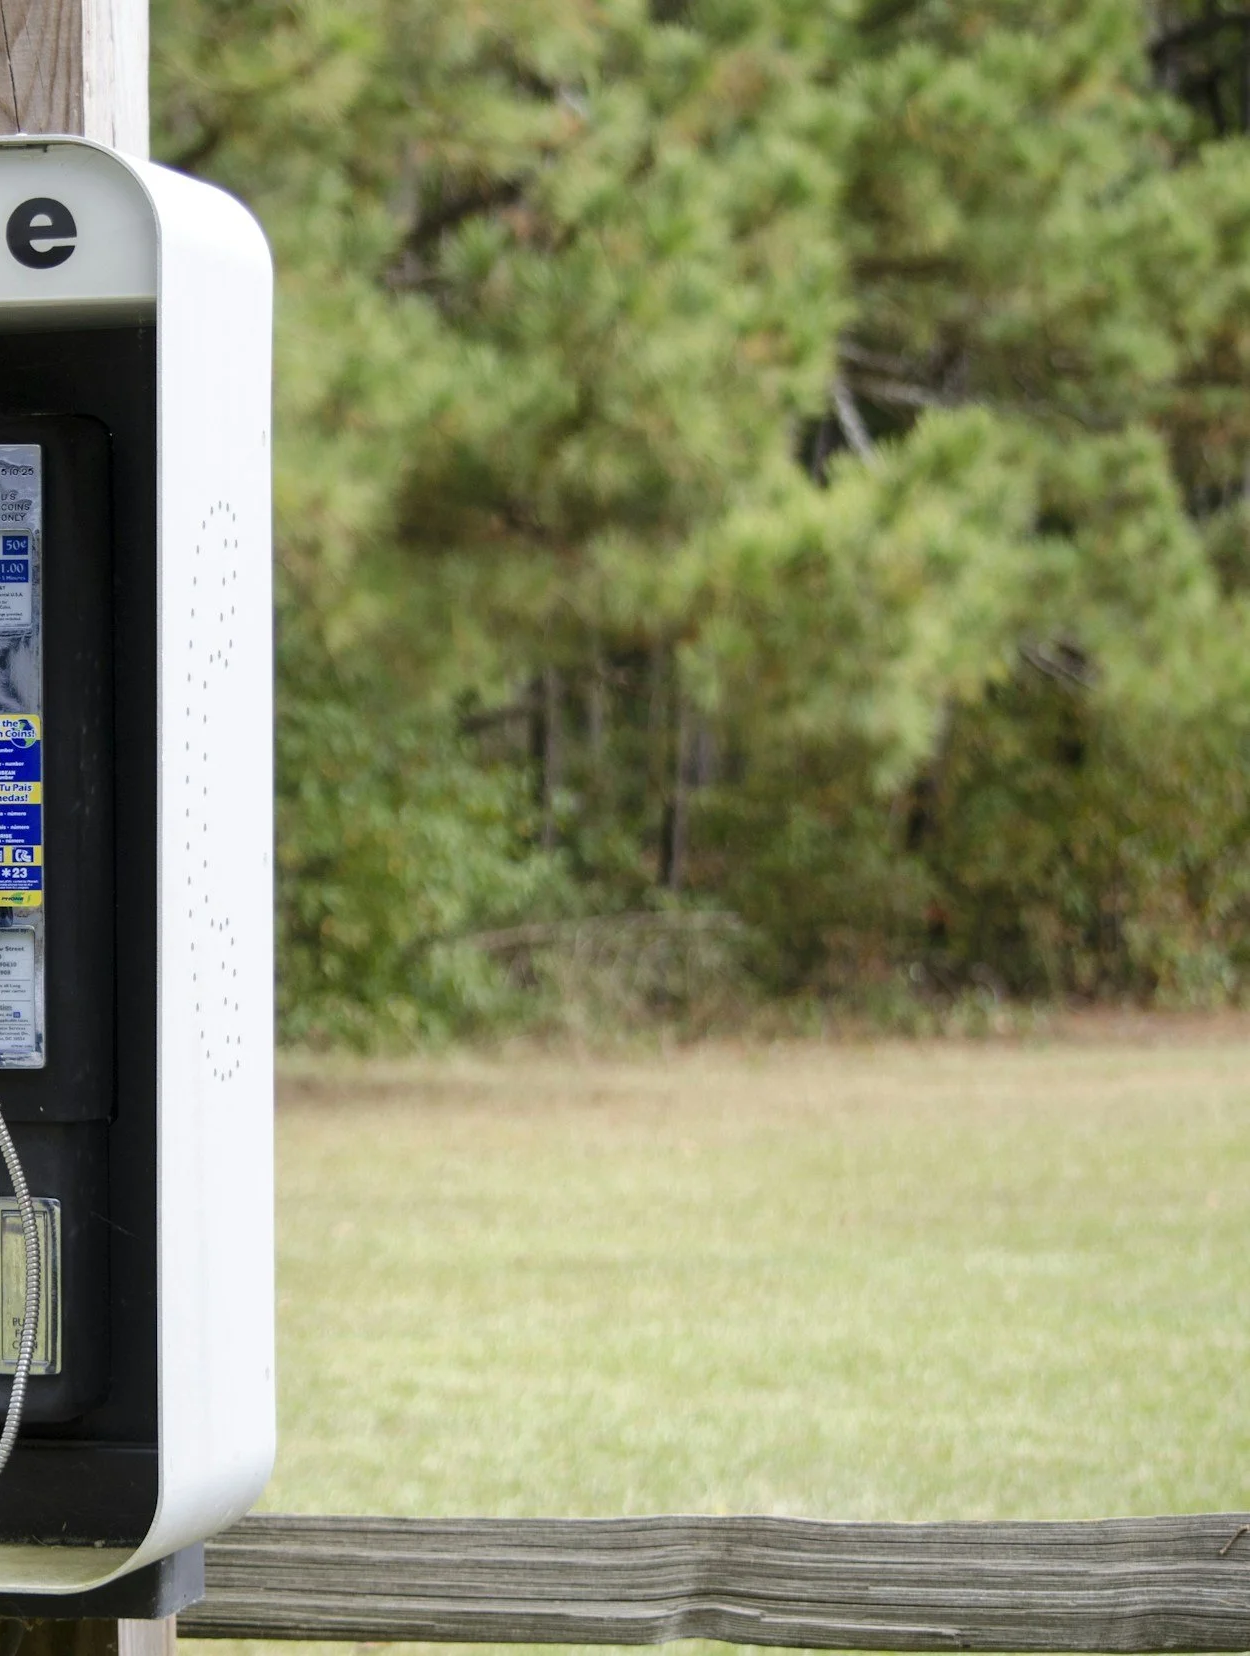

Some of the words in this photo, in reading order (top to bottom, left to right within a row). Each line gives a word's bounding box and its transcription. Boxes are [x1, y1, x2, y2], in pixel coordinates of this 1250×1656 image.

[1, 503, 30, 511] COINS
[1, 514, 26, 522] ONLY
[5, 730, 35, 738] Coins!
